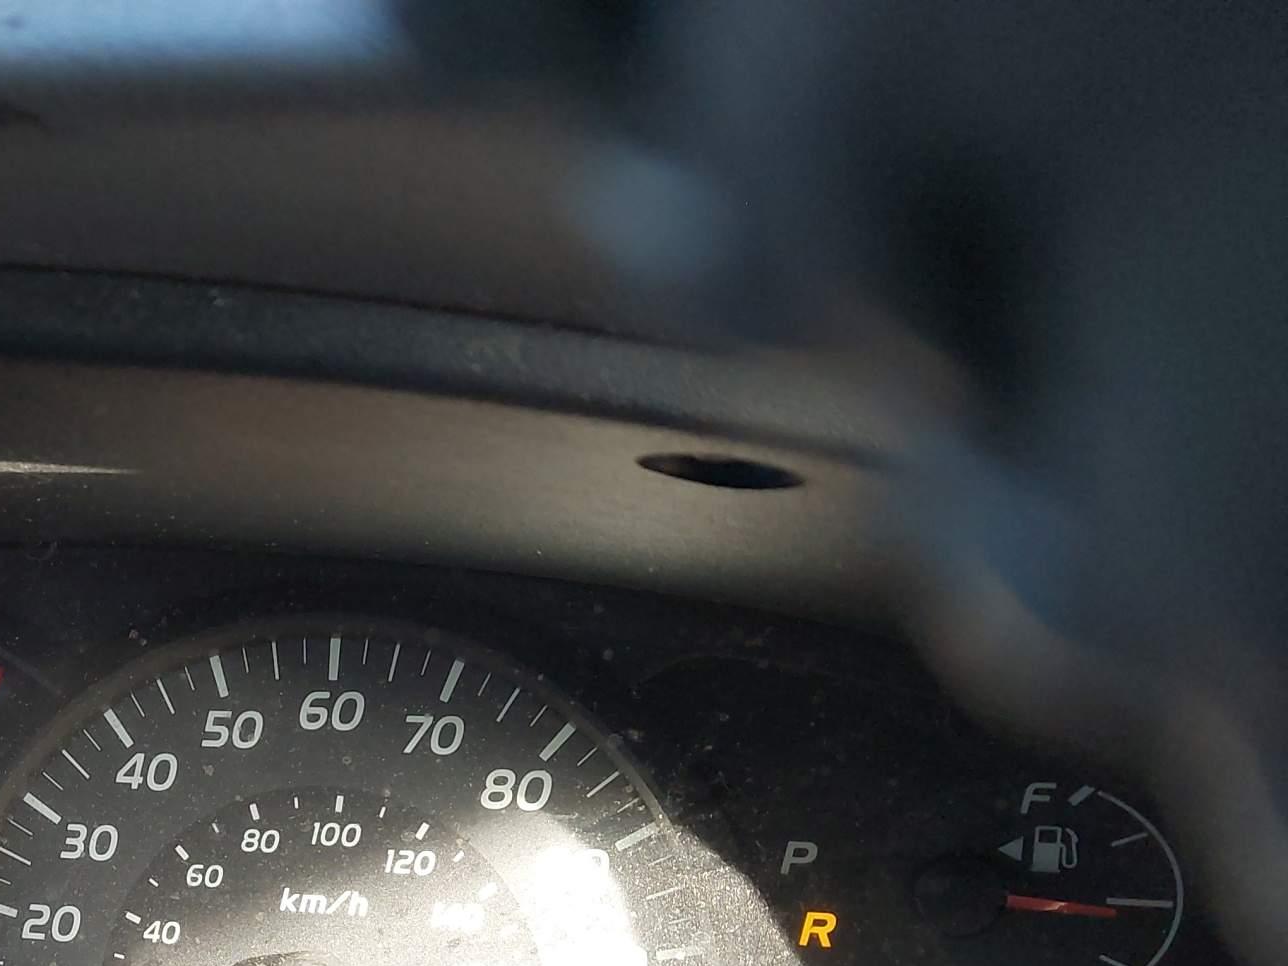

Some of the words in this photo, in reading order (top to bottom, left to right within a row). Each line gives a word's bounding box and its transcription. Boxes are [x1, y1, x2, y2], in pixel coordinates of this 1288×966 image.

[299, 690, 365, 732] 60
[201, 710, 264, 750] 50
[402, 714, 465, 756] 70
[115, 752, 178, 792] 40
[480, 768, 553, 811] 80
[1020, 782, 1058, 815] F
[59, 823, 119, 861] 30
[241, 829, 280, 854] 80
[311, 822, 362, 848] 100
[384, 848, 437, 877] 120
[780, 841, 818, 875] P
[186, 864, 224, 888] 60
[278, 887, 369, 918] km/h
[21, 903, 81, 944] 20
[142, 920, 181, 945] 40
[799, 911, 838, 948] R
